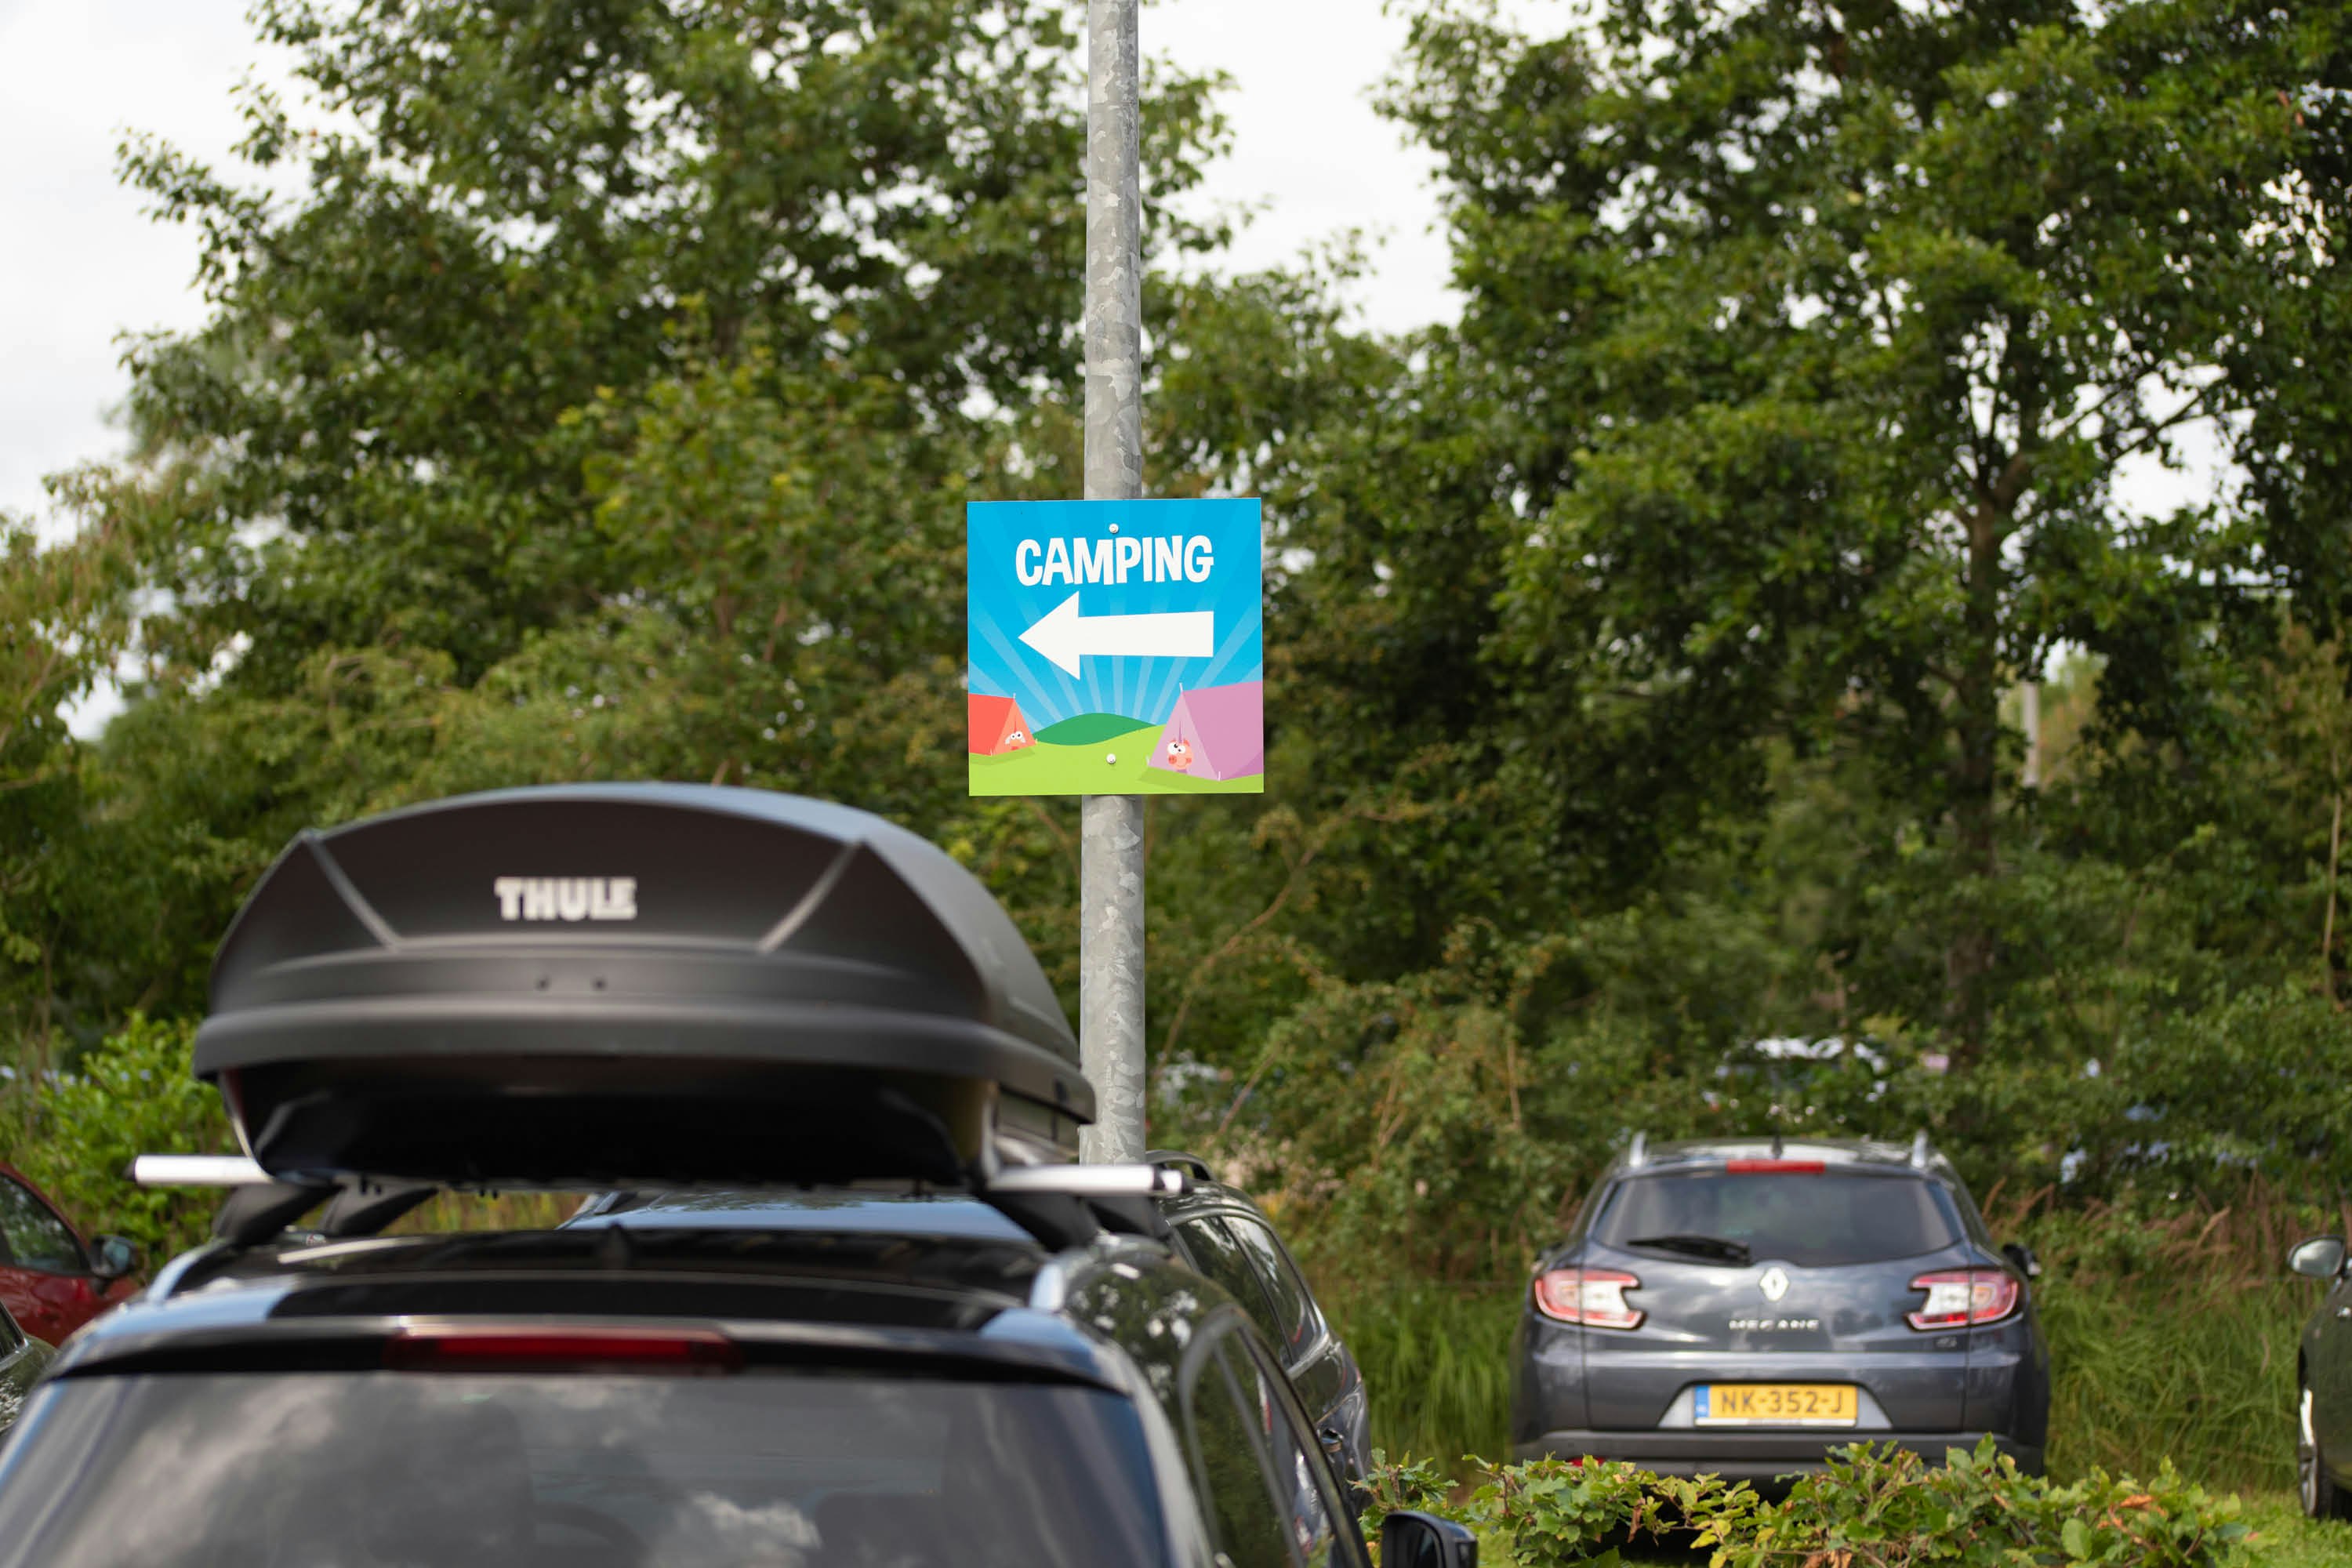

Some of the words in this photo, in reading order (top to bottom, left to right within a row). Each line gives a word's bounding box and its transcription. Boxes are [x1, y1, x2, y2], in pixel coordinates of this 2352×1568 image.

[1016, 535, 1214, 586] CAMPING
[494, 876, 637, 921] THULE
[1720, 1390, 1842, 1414] NK-352-J
